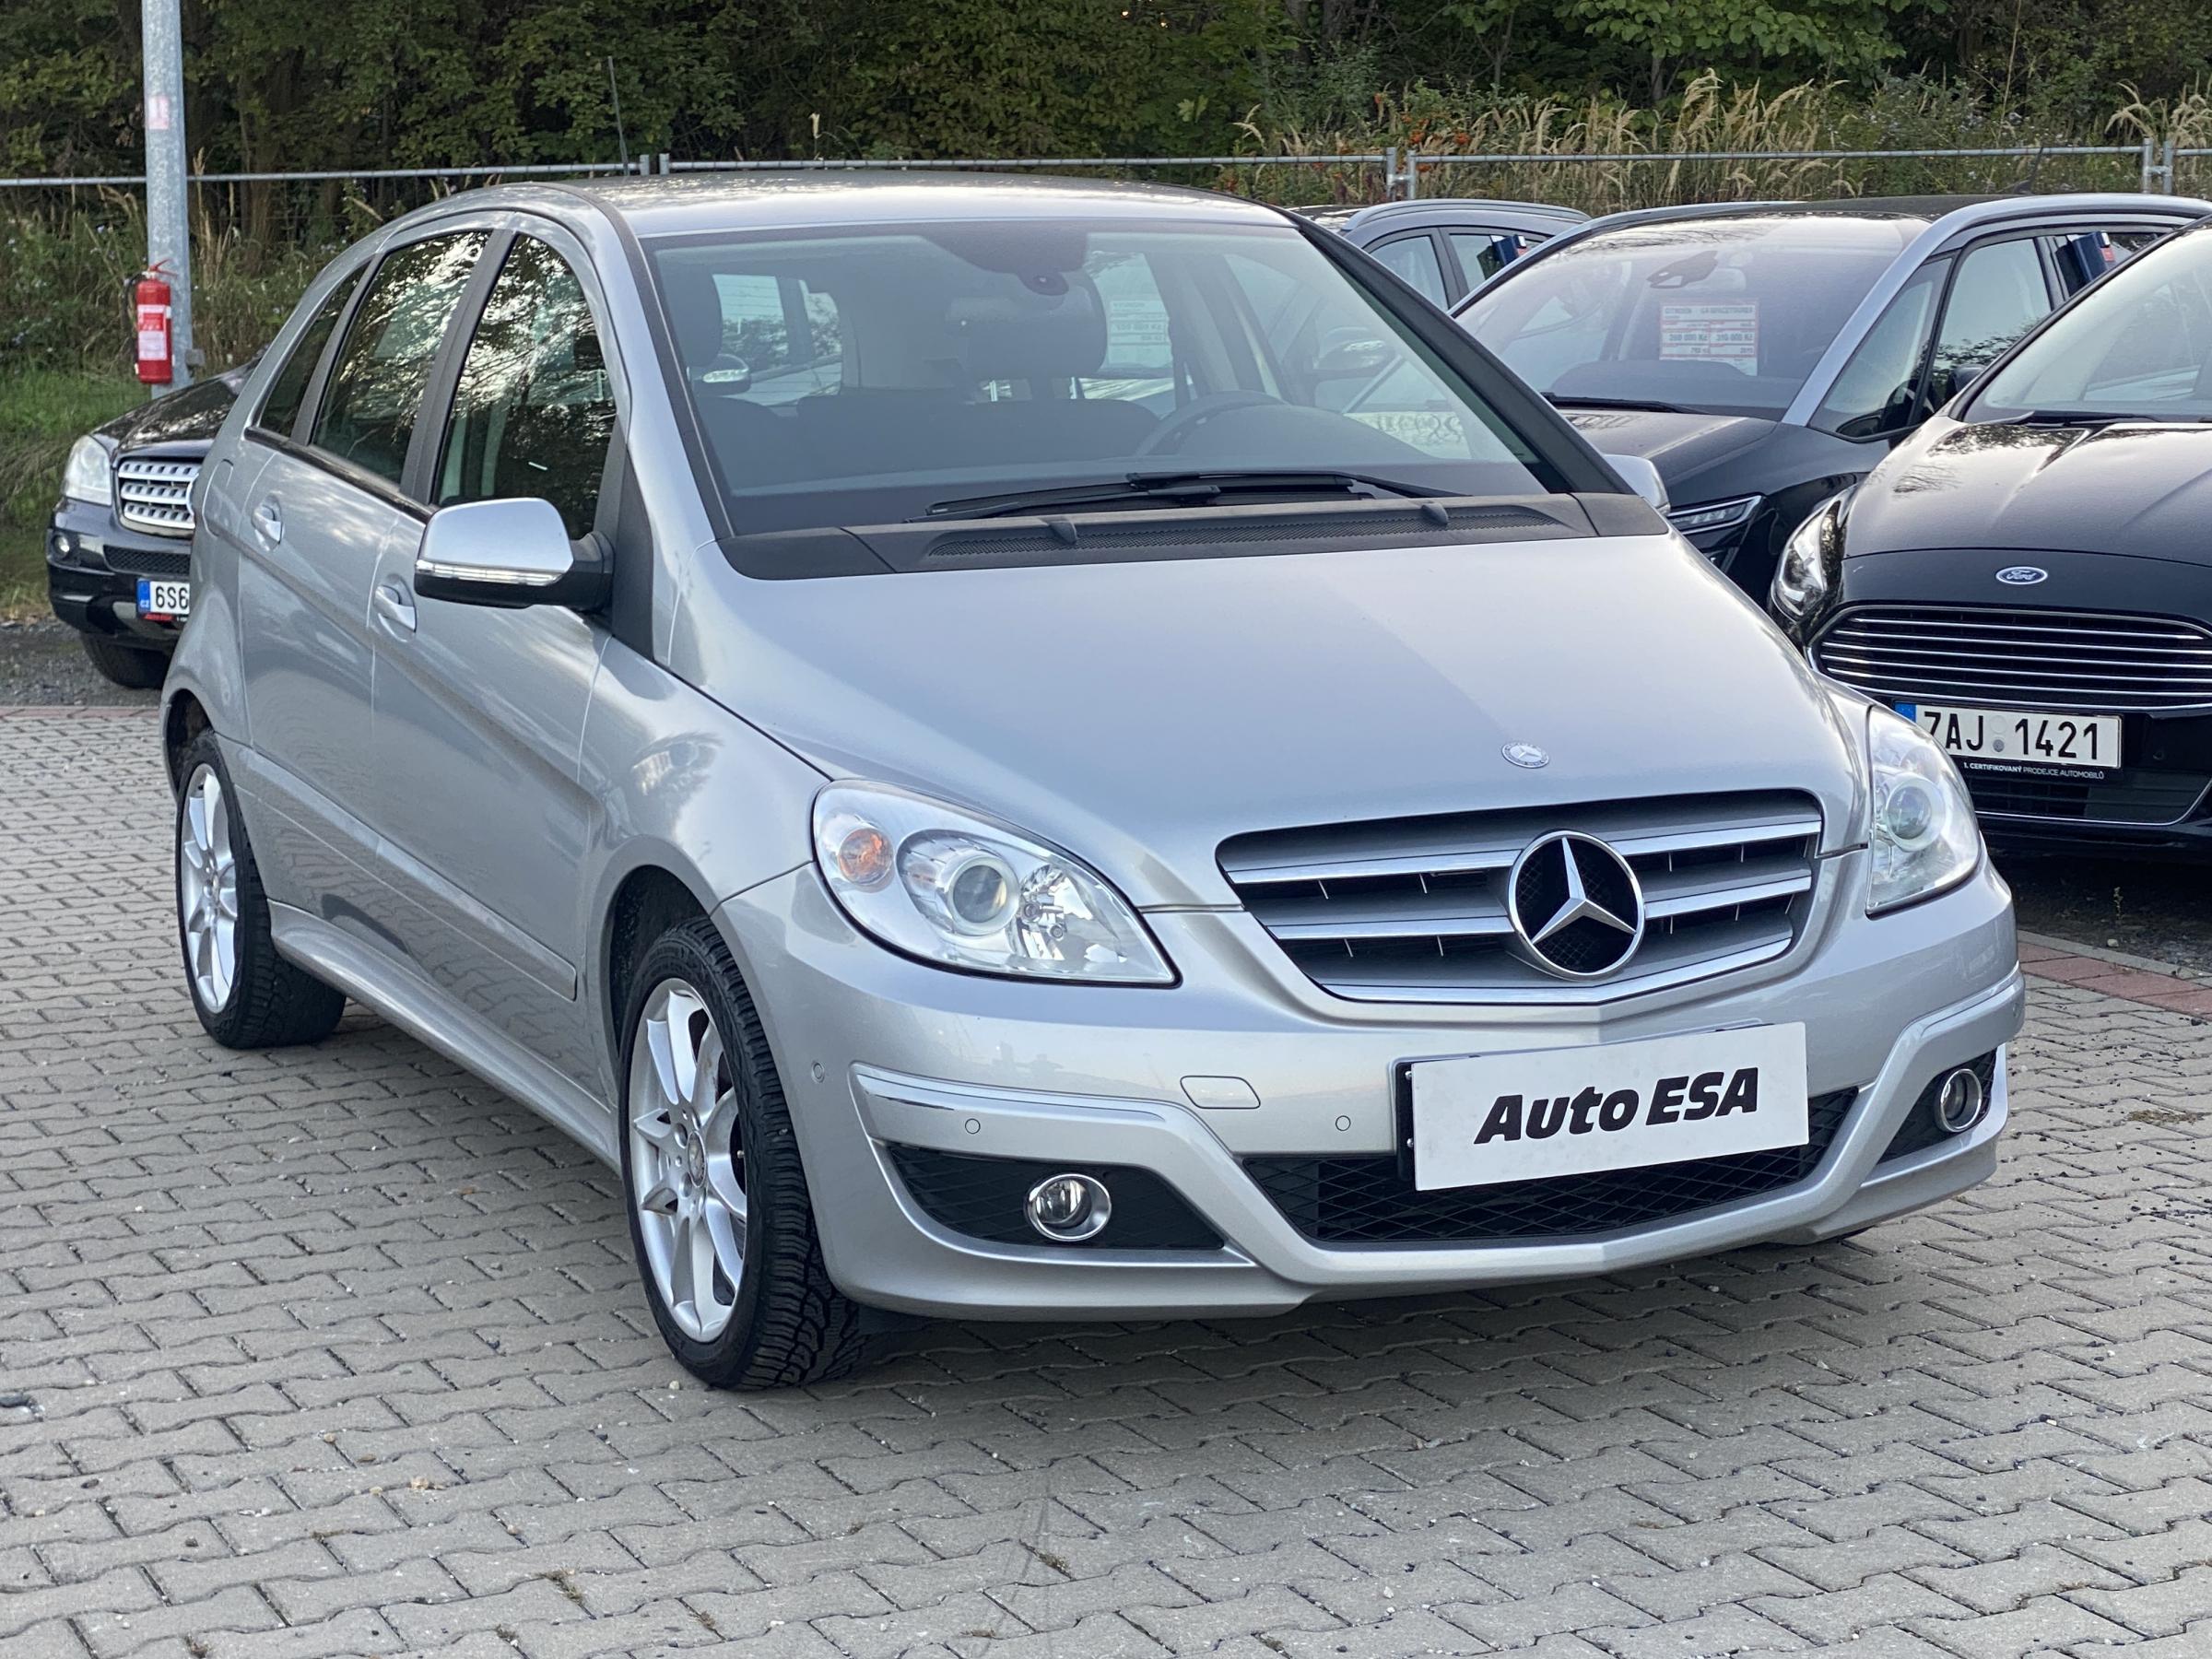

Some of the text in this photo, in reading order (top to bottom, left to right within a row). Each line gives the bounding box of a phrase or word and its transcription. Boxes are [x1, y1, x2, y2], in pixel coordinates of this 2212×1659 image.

[156, 585, 188, 610] 6S6
[1924, 711, 2098, 760] 7AJ 1421
[1970, 762, 2023, 773] CERTIFIKOVANÝ
[2023, 767, 2059, 777] PRODEJCE
[2059, 769, 2105, 781] AUTOMOBILŮ
[1473, 1066, 1759, 1145] Auto ESA
